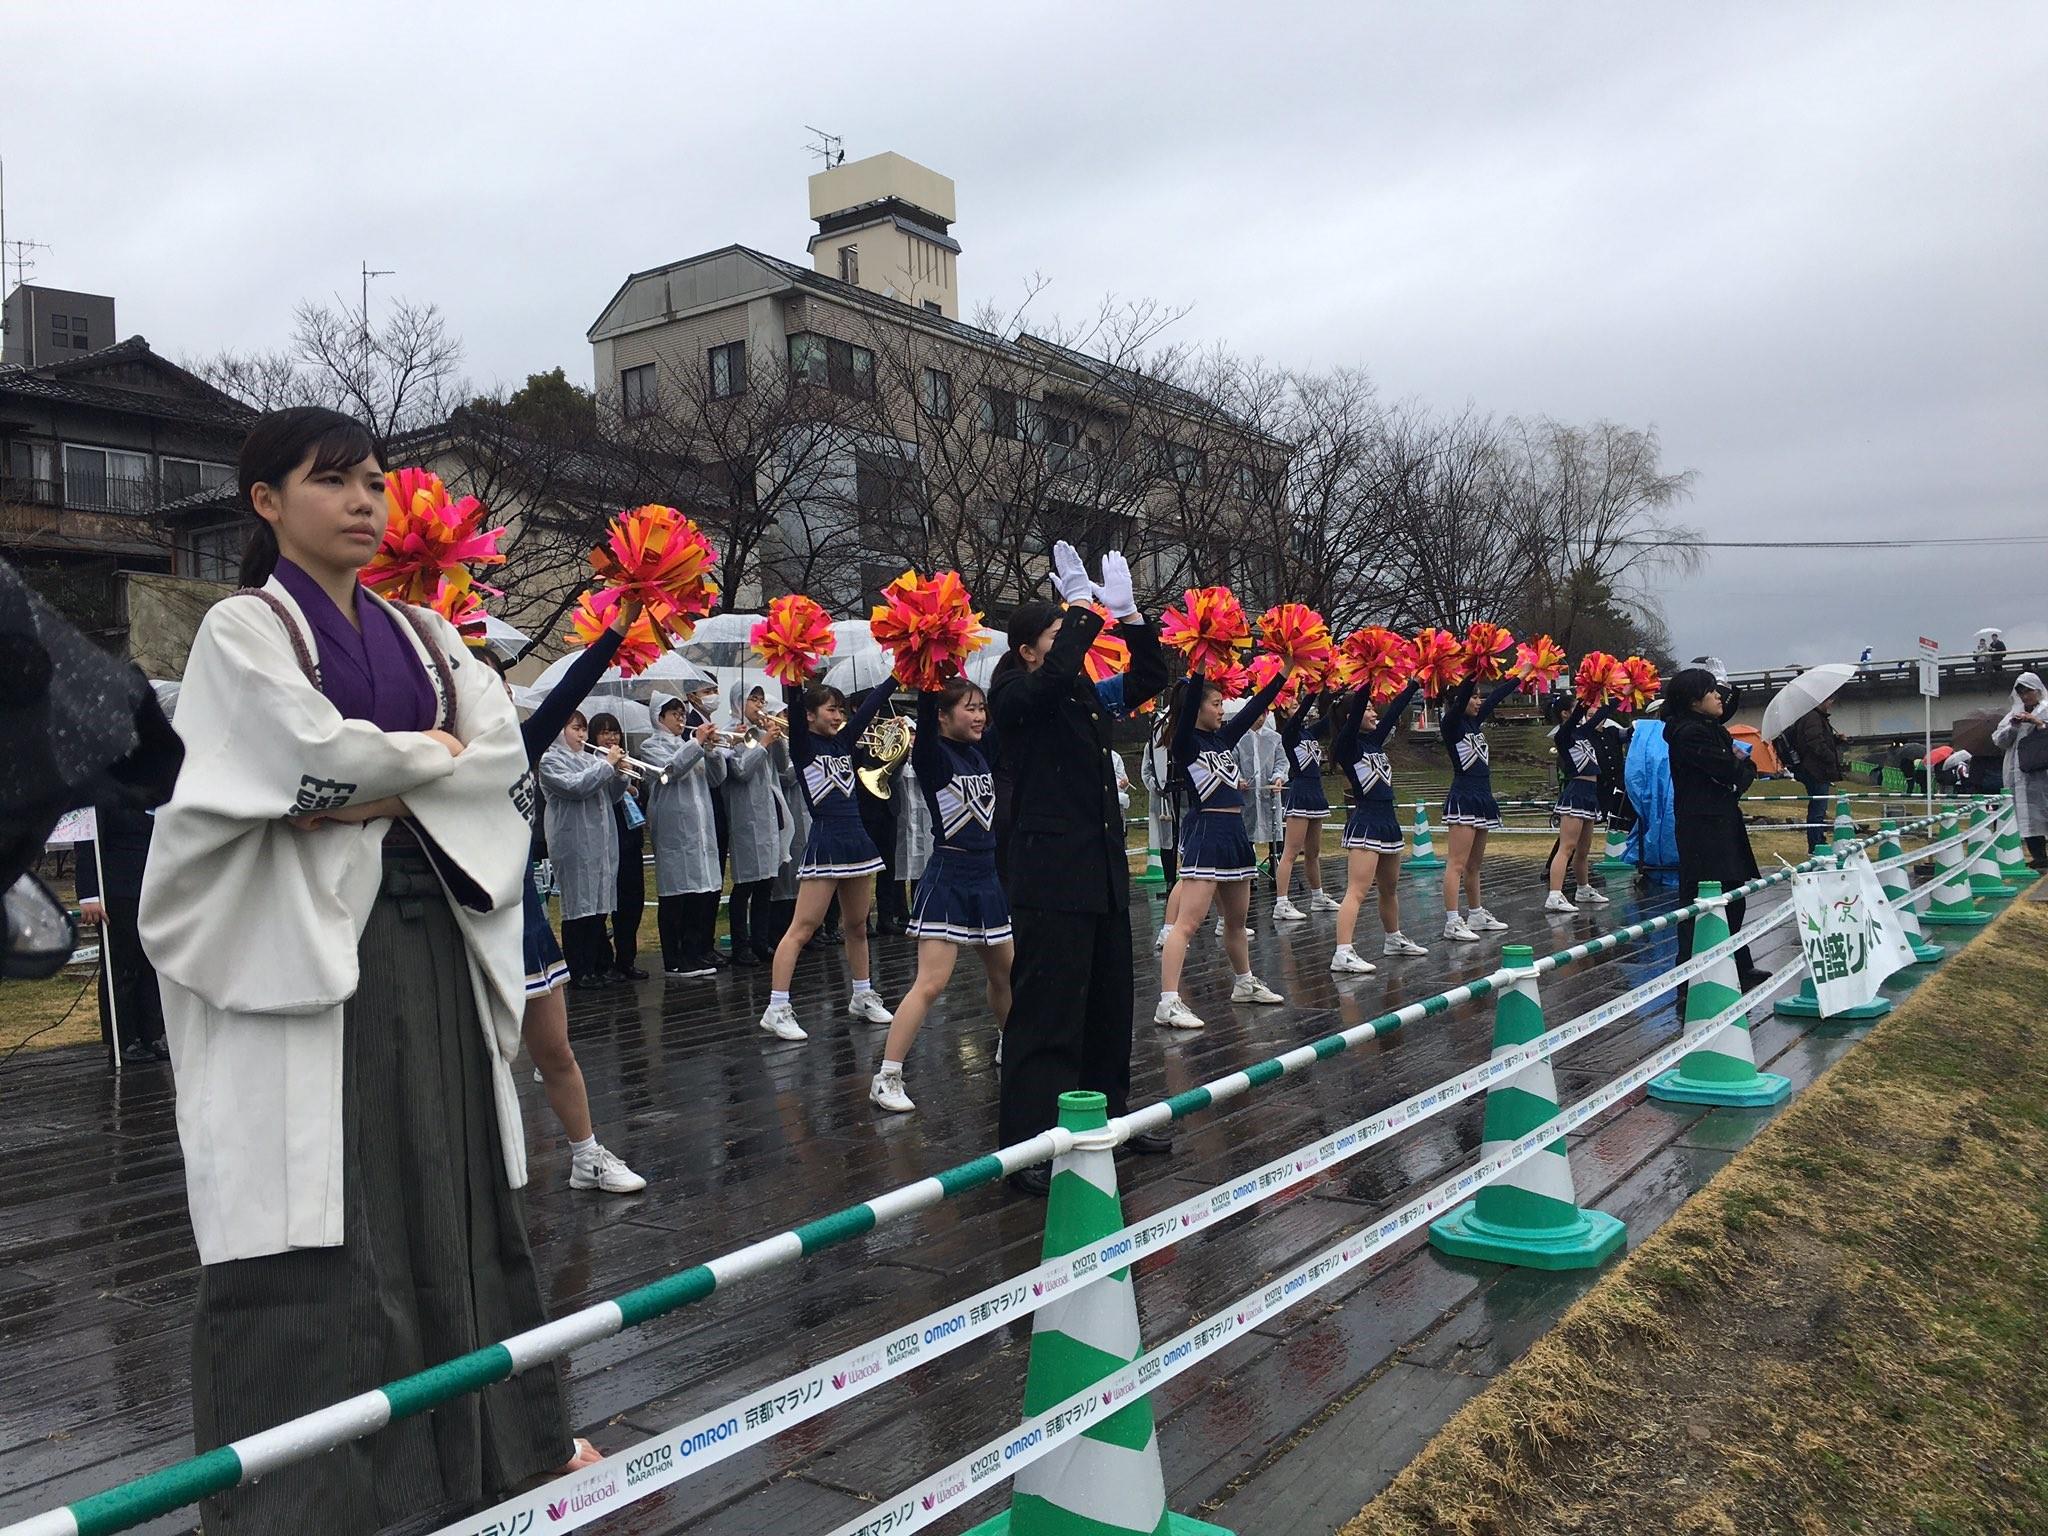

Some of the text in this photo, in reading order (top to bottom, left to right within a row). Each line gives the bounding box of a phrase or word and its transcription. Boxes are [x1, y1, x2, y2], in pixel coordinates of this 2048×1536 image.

[820, 755, 853, 779] KYOS
[960, 774, 995, 805] KYOS
[1134, 1217, 1178, 1249] 京都マラソン
[1072, 1252, 1097, 1271] KYOTO
[1100, 1239, 1132, 1263] OMRON
[970, 1286, 1027, 1325] 京都マラソン
[924, 1315, 966, 1345] OMRON
[1194, 1316, 1234, 1350] 京都マラソン
[886, 1333, 919, 1358] KYOTO
[887, 1346, 920, 1367] MARATHON
[1163, 1341, 1192, 1366] OMRON
[848, 1360, 882, 1385] Wacoal
[1137, 1357, 1161, 1377] KYOTO
[745, 1378, 824, 1430] 京都マラソン
[1045, 1396, 1097, 1439] 京都マラソン
[680, 1418, 738, 1457] OMRON
[1004, 1428, 1042, 1460] OMRON
[625, 1444, 672, 1476] KYOTO
[627, 1459, 673, 1488] MARATHON
[970, 1449, 1000, 1476] KYOTO
[971, 1463, 1001, 1484] MARATHON
[570, 1481, 617, 1513] Wacoal
[935, 1478, 967, 1505] Wacoal
[472, 1509, 533, 1536] ラソン
[849, 1501, 914, 1536] マラソン
